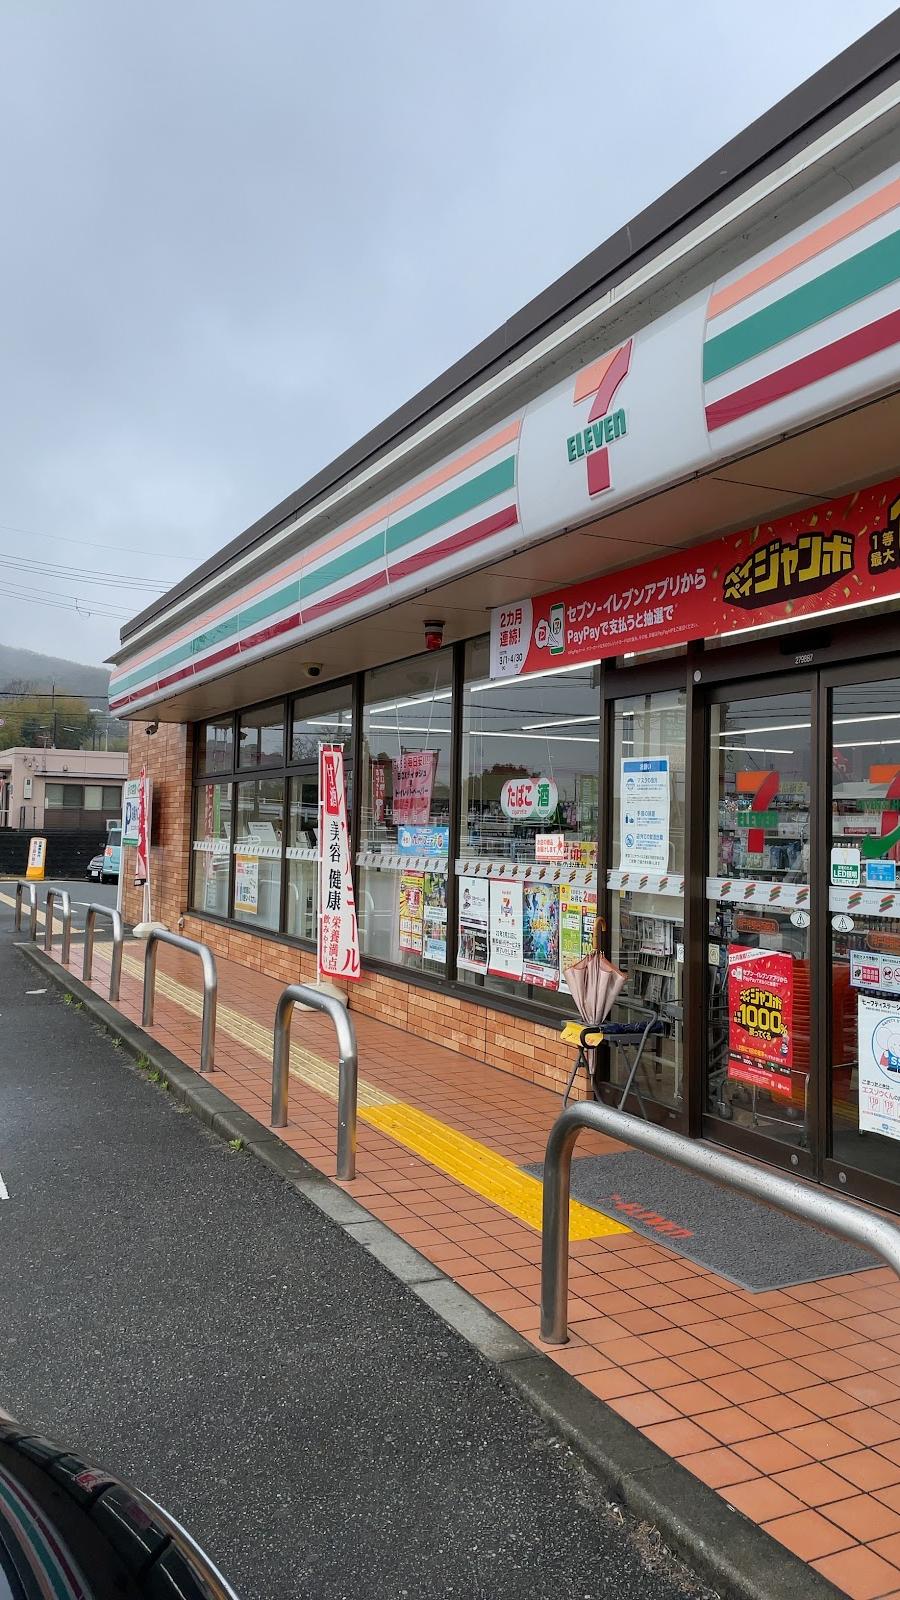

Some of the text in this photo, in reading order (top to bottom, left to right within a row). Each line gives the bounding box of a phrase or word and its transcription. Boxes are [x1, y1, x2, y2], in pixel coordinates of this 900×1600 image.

[872, 530, 894, 550] 1等
[871, 550, 895, 567] 最大
[567, 605, 674, 645] PayPayで支払うと抽選で
[507, 783, 550, 807] たばこ 酒
[329, 821, 341, 864] 美容
[326, 868, 342, 911] 健康
[833, 870, 858, 879] LED照明
[328, 916, 341, 970] 栄養満点
